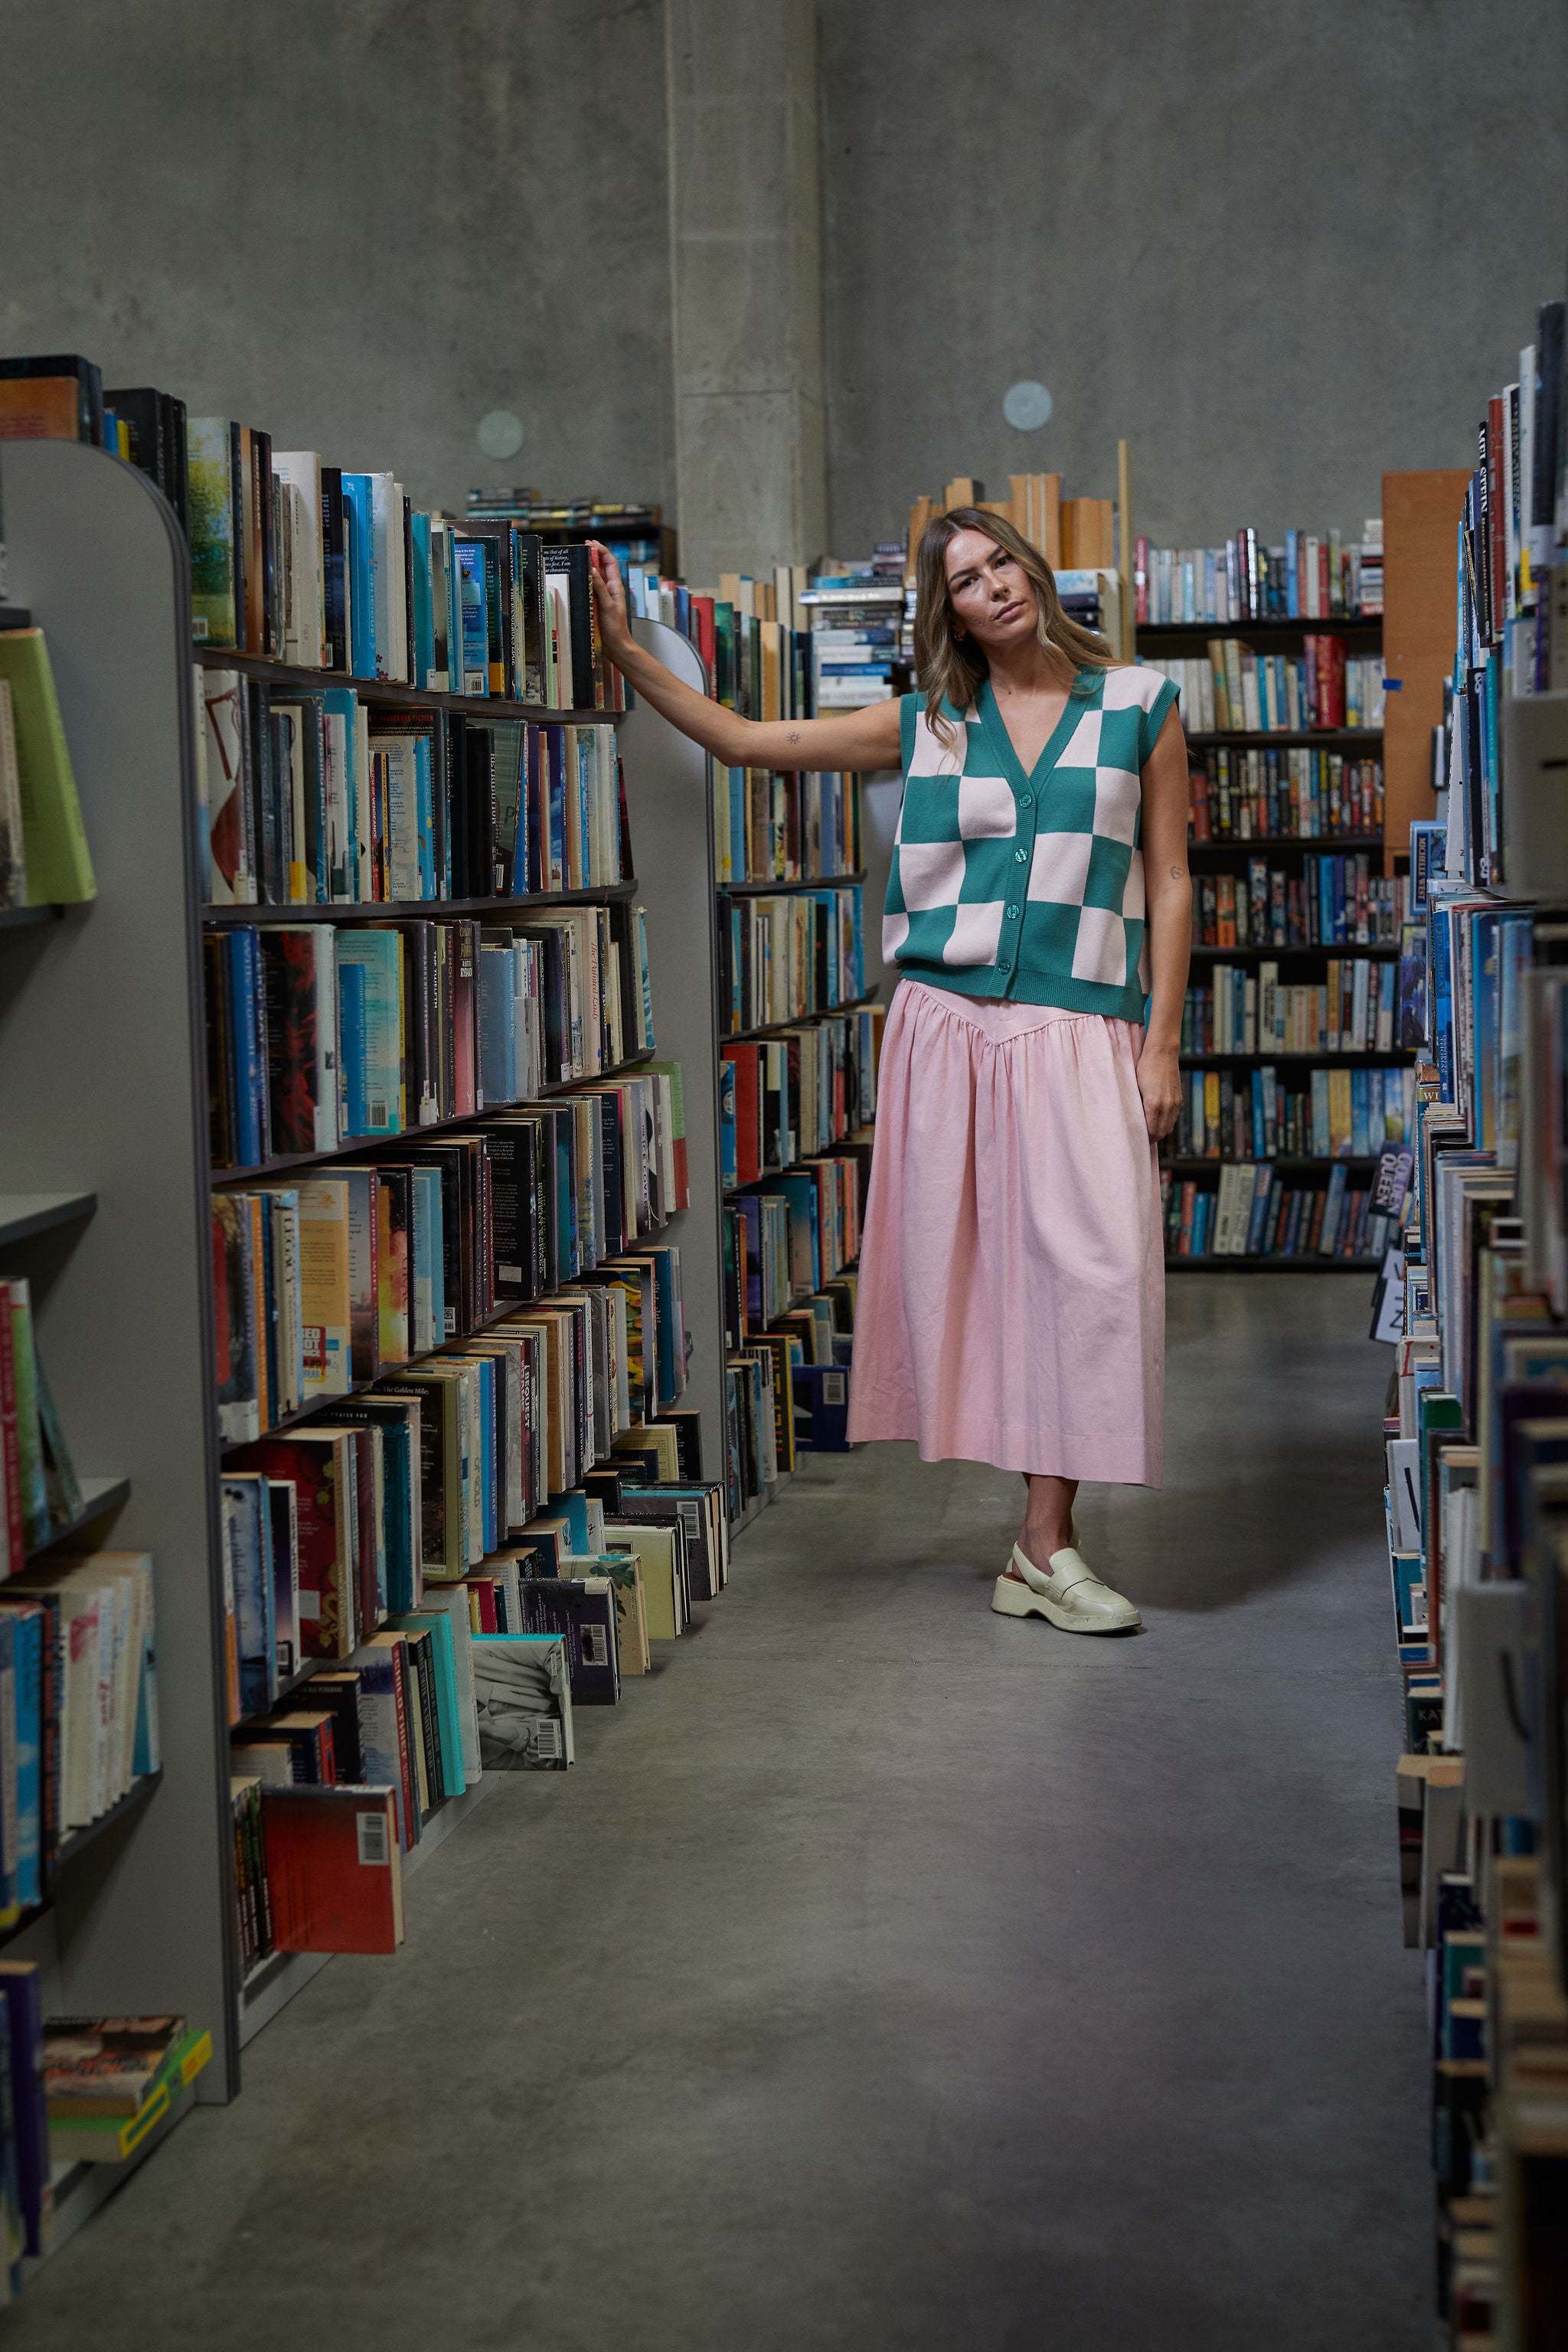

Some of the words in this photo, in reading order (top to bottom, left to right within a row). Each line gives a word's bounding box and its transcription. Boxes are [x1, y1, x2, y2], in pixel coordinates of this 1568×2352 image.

[1479, 466, 1488, 513] STEIN
[1436, 923, 1445, 995] DRUMBEAT
[1374, 1152, 1397, 1206] QUEEN
[1385, 1152, 1411, 1215] GOLDEN
[284, 1217, 293, 1286] LEGACY
[395, 1658, 403, 1707] CHILD
[398, 1713, 407, 1759] THIEF
